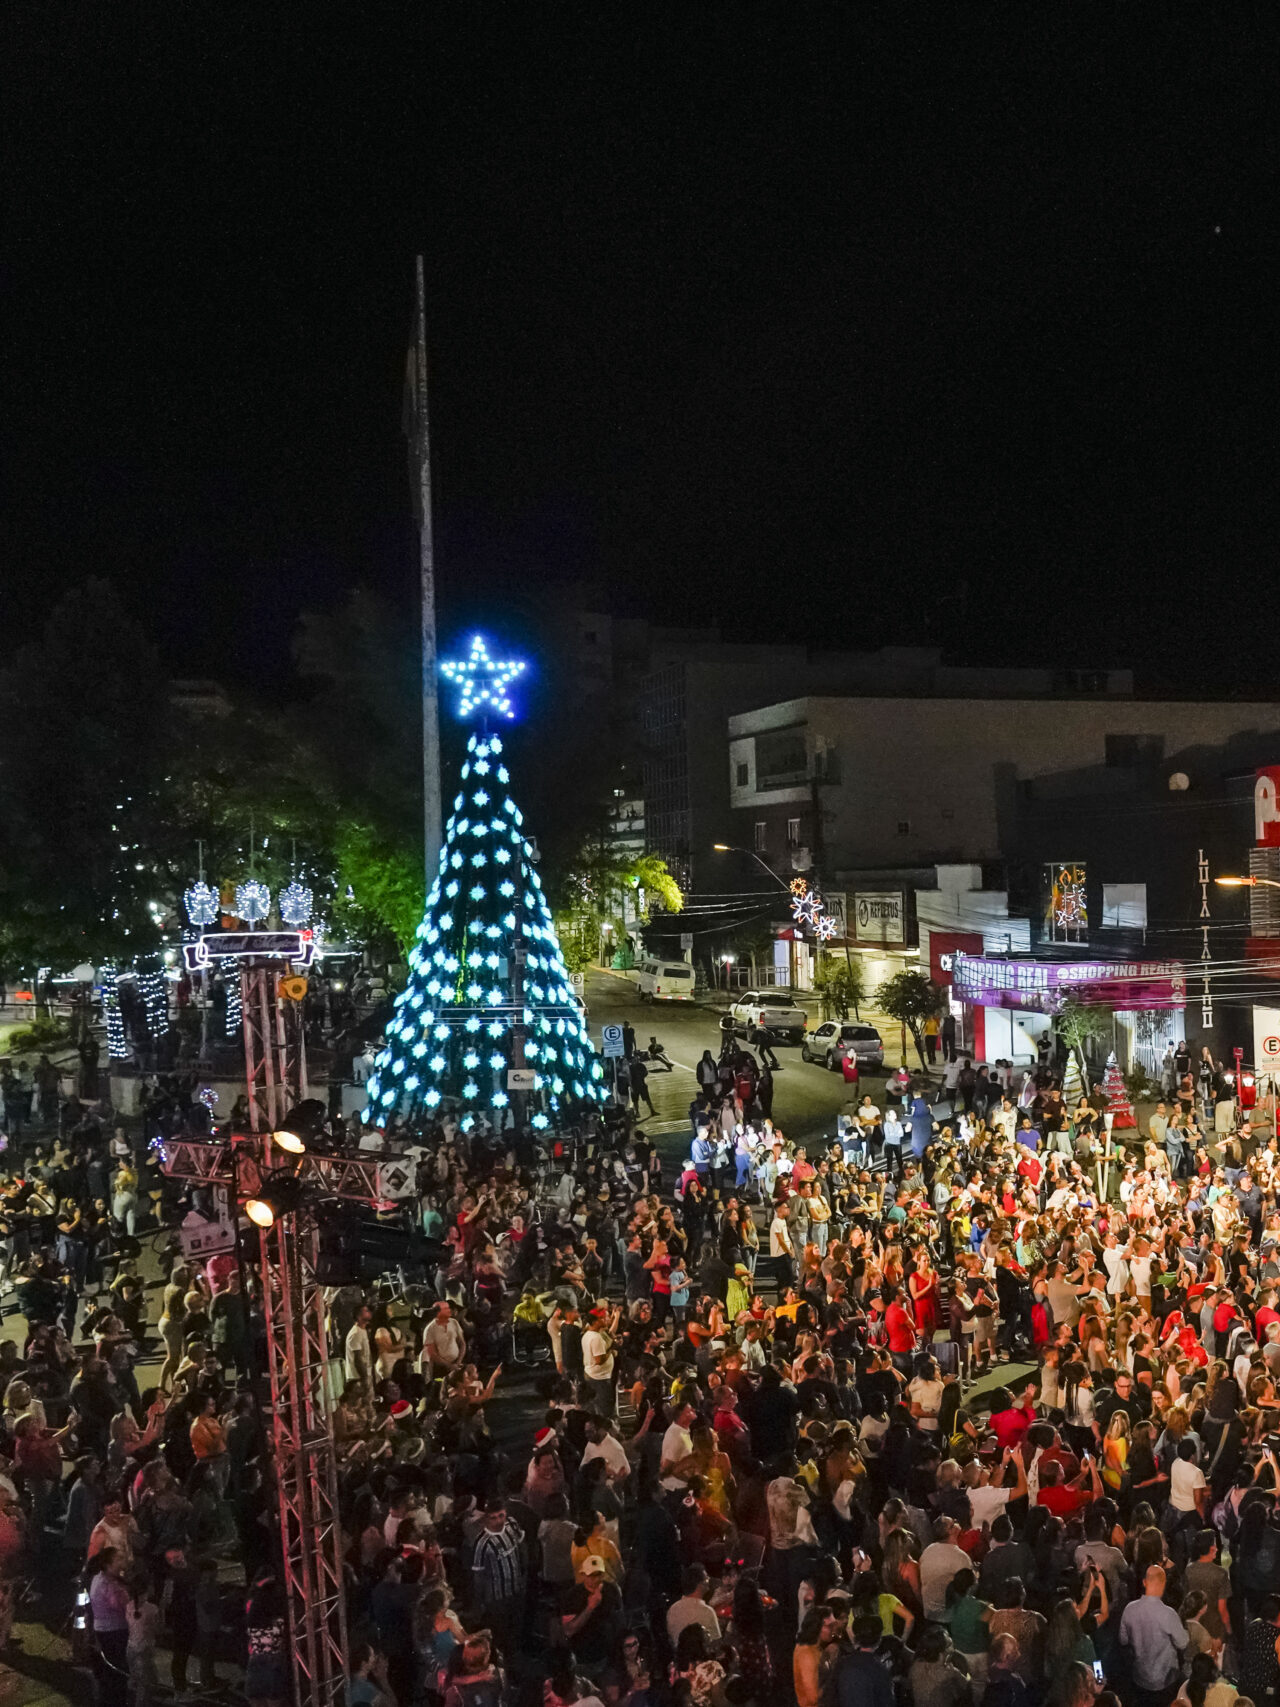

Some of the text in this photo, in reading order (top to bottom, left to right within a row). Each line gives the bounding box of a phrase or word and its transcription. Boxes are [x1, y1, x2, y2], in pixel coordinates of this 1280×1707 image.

[954, 960, 1048, 988] SHOPPING REAL
[1070, 964, 1137, 980] SHOPPING
[610, 1029, 616, 1038] E
[1269, 1040, 1277, 1052] E
